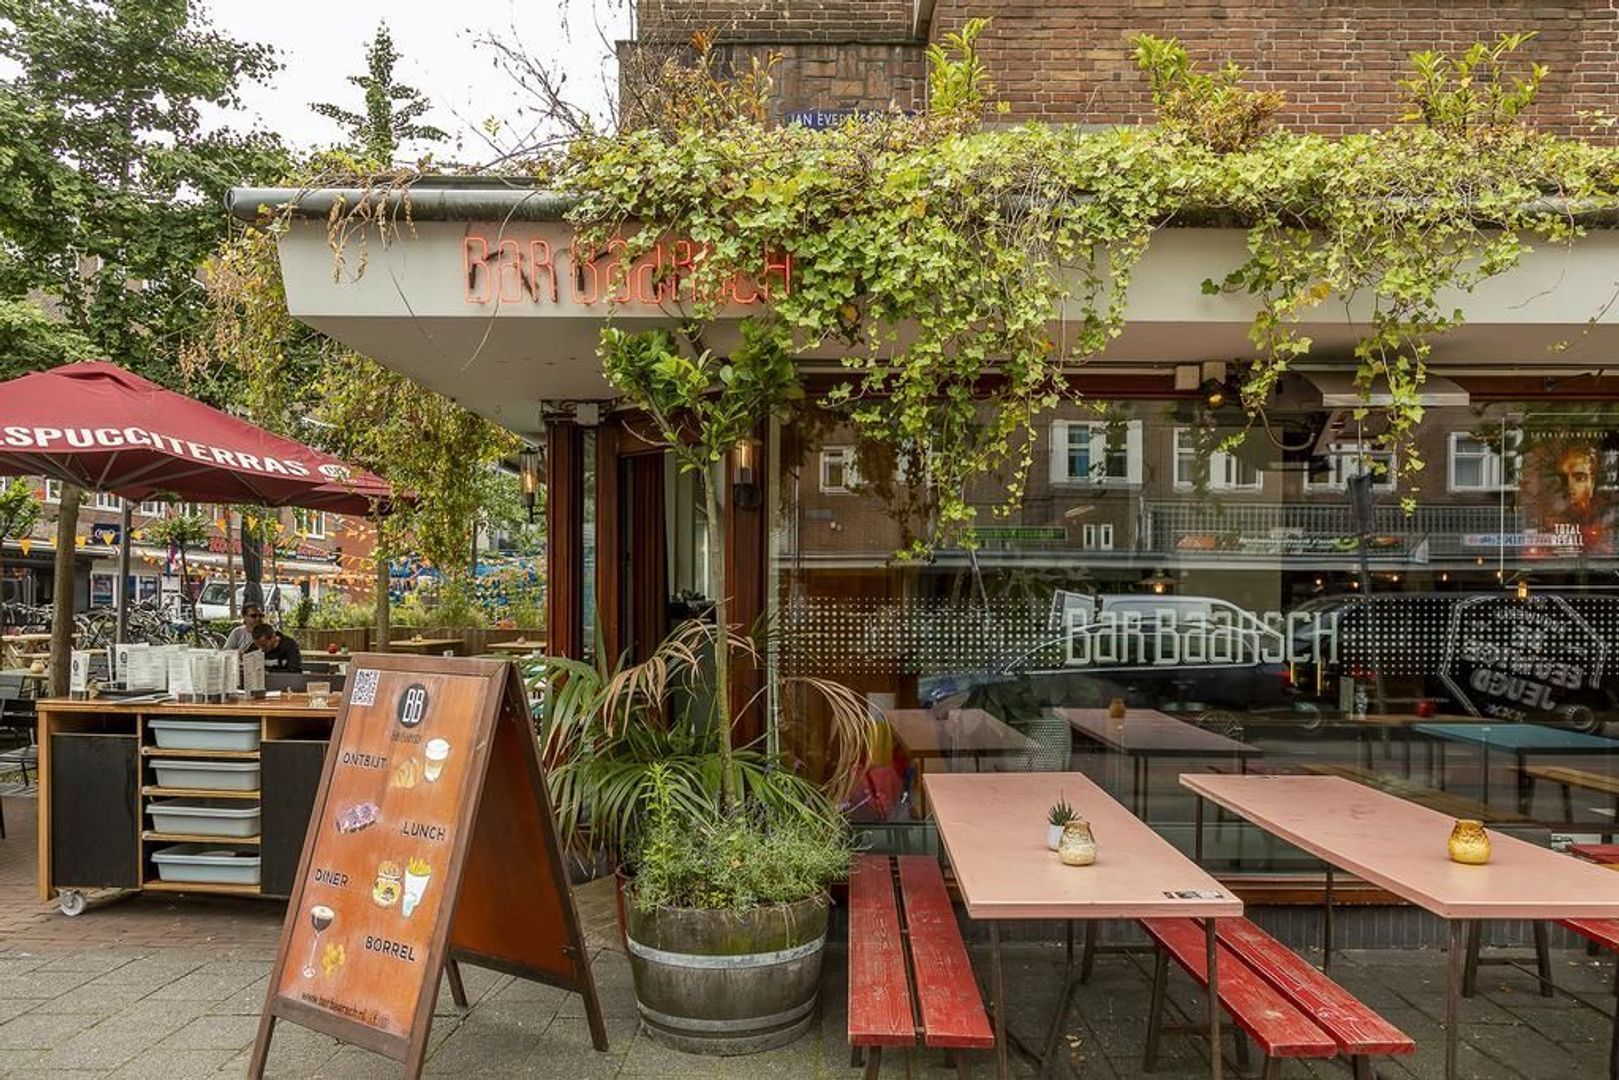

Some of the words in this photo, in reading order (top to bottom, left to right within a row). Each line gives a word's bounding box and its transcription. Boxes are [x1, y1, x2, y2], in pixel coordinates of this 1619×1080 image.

[0, 426, 310, 477] SPUCCITERRAS
[1554, 523, 1581, 534] TOTAL
[1551, 535, 1584, 547] RECALL
[402, 688, 425, 723] BB
[343, 752, 388, 769] ONTBIJT
[403, 821, 446, 841] LUNCH
[314, 868, 350, 887] DINER
[364, 935, 417, 962] BORREL
